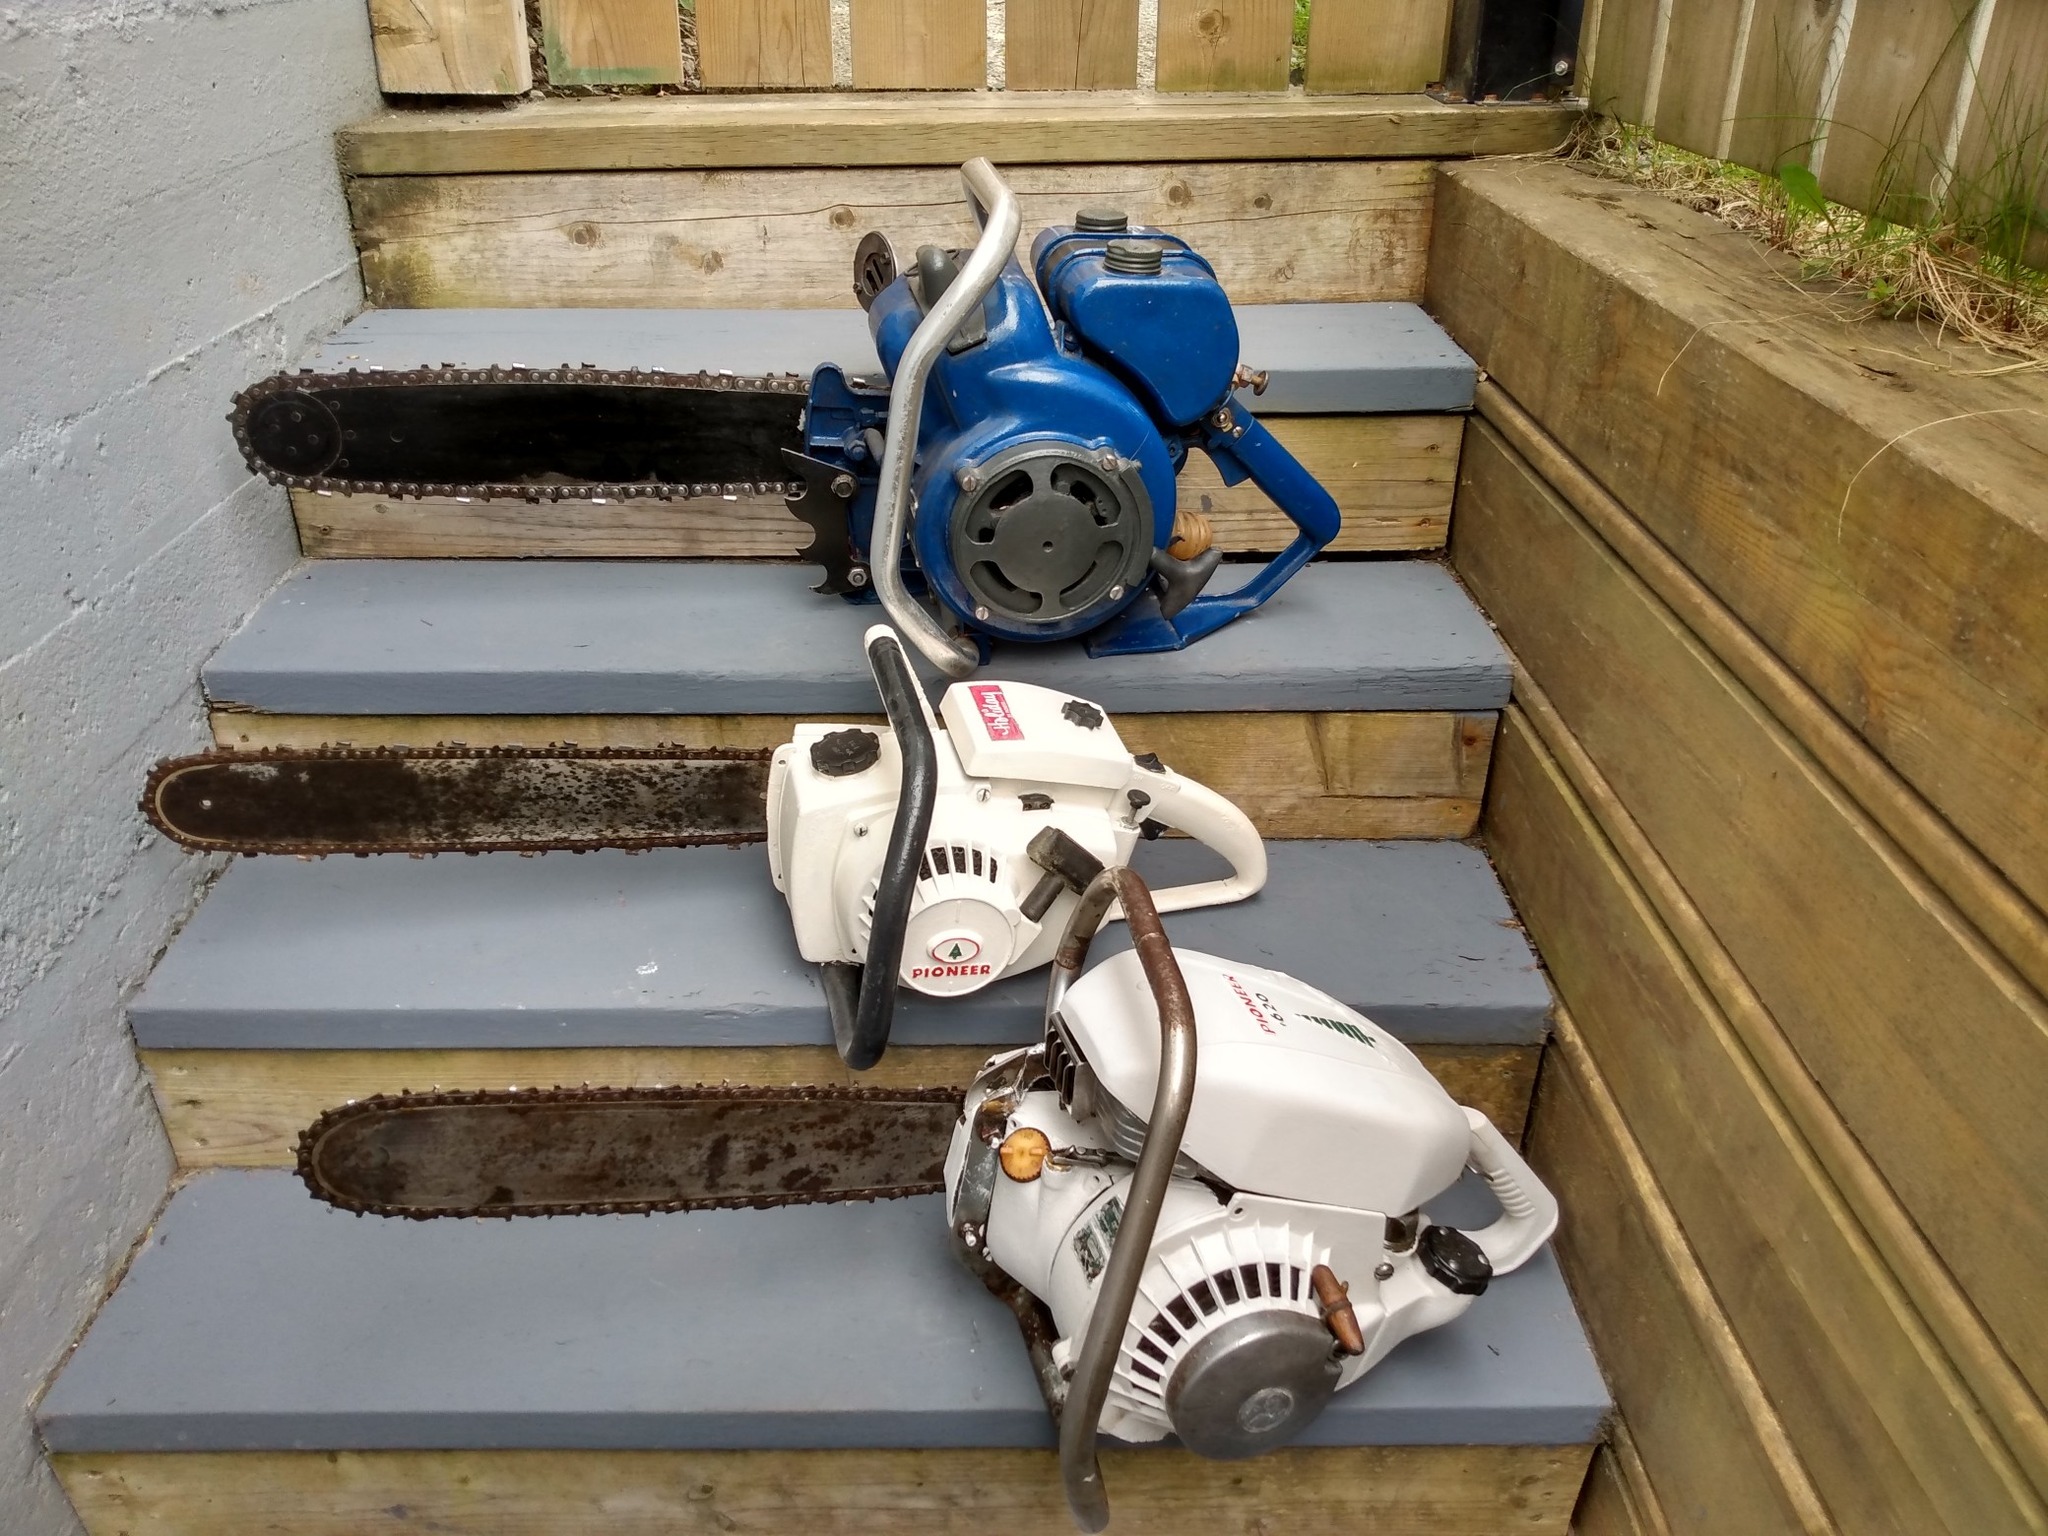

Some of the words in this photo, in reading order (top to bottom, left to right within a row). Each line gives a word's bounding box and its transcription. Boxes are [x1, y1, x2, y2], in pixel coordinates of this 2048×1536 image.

[980, 691, 1011, 736] Holiday
[912, 965, 991, 978] PIONEER
[1222, 974, 1276, 1034] PIONEER
